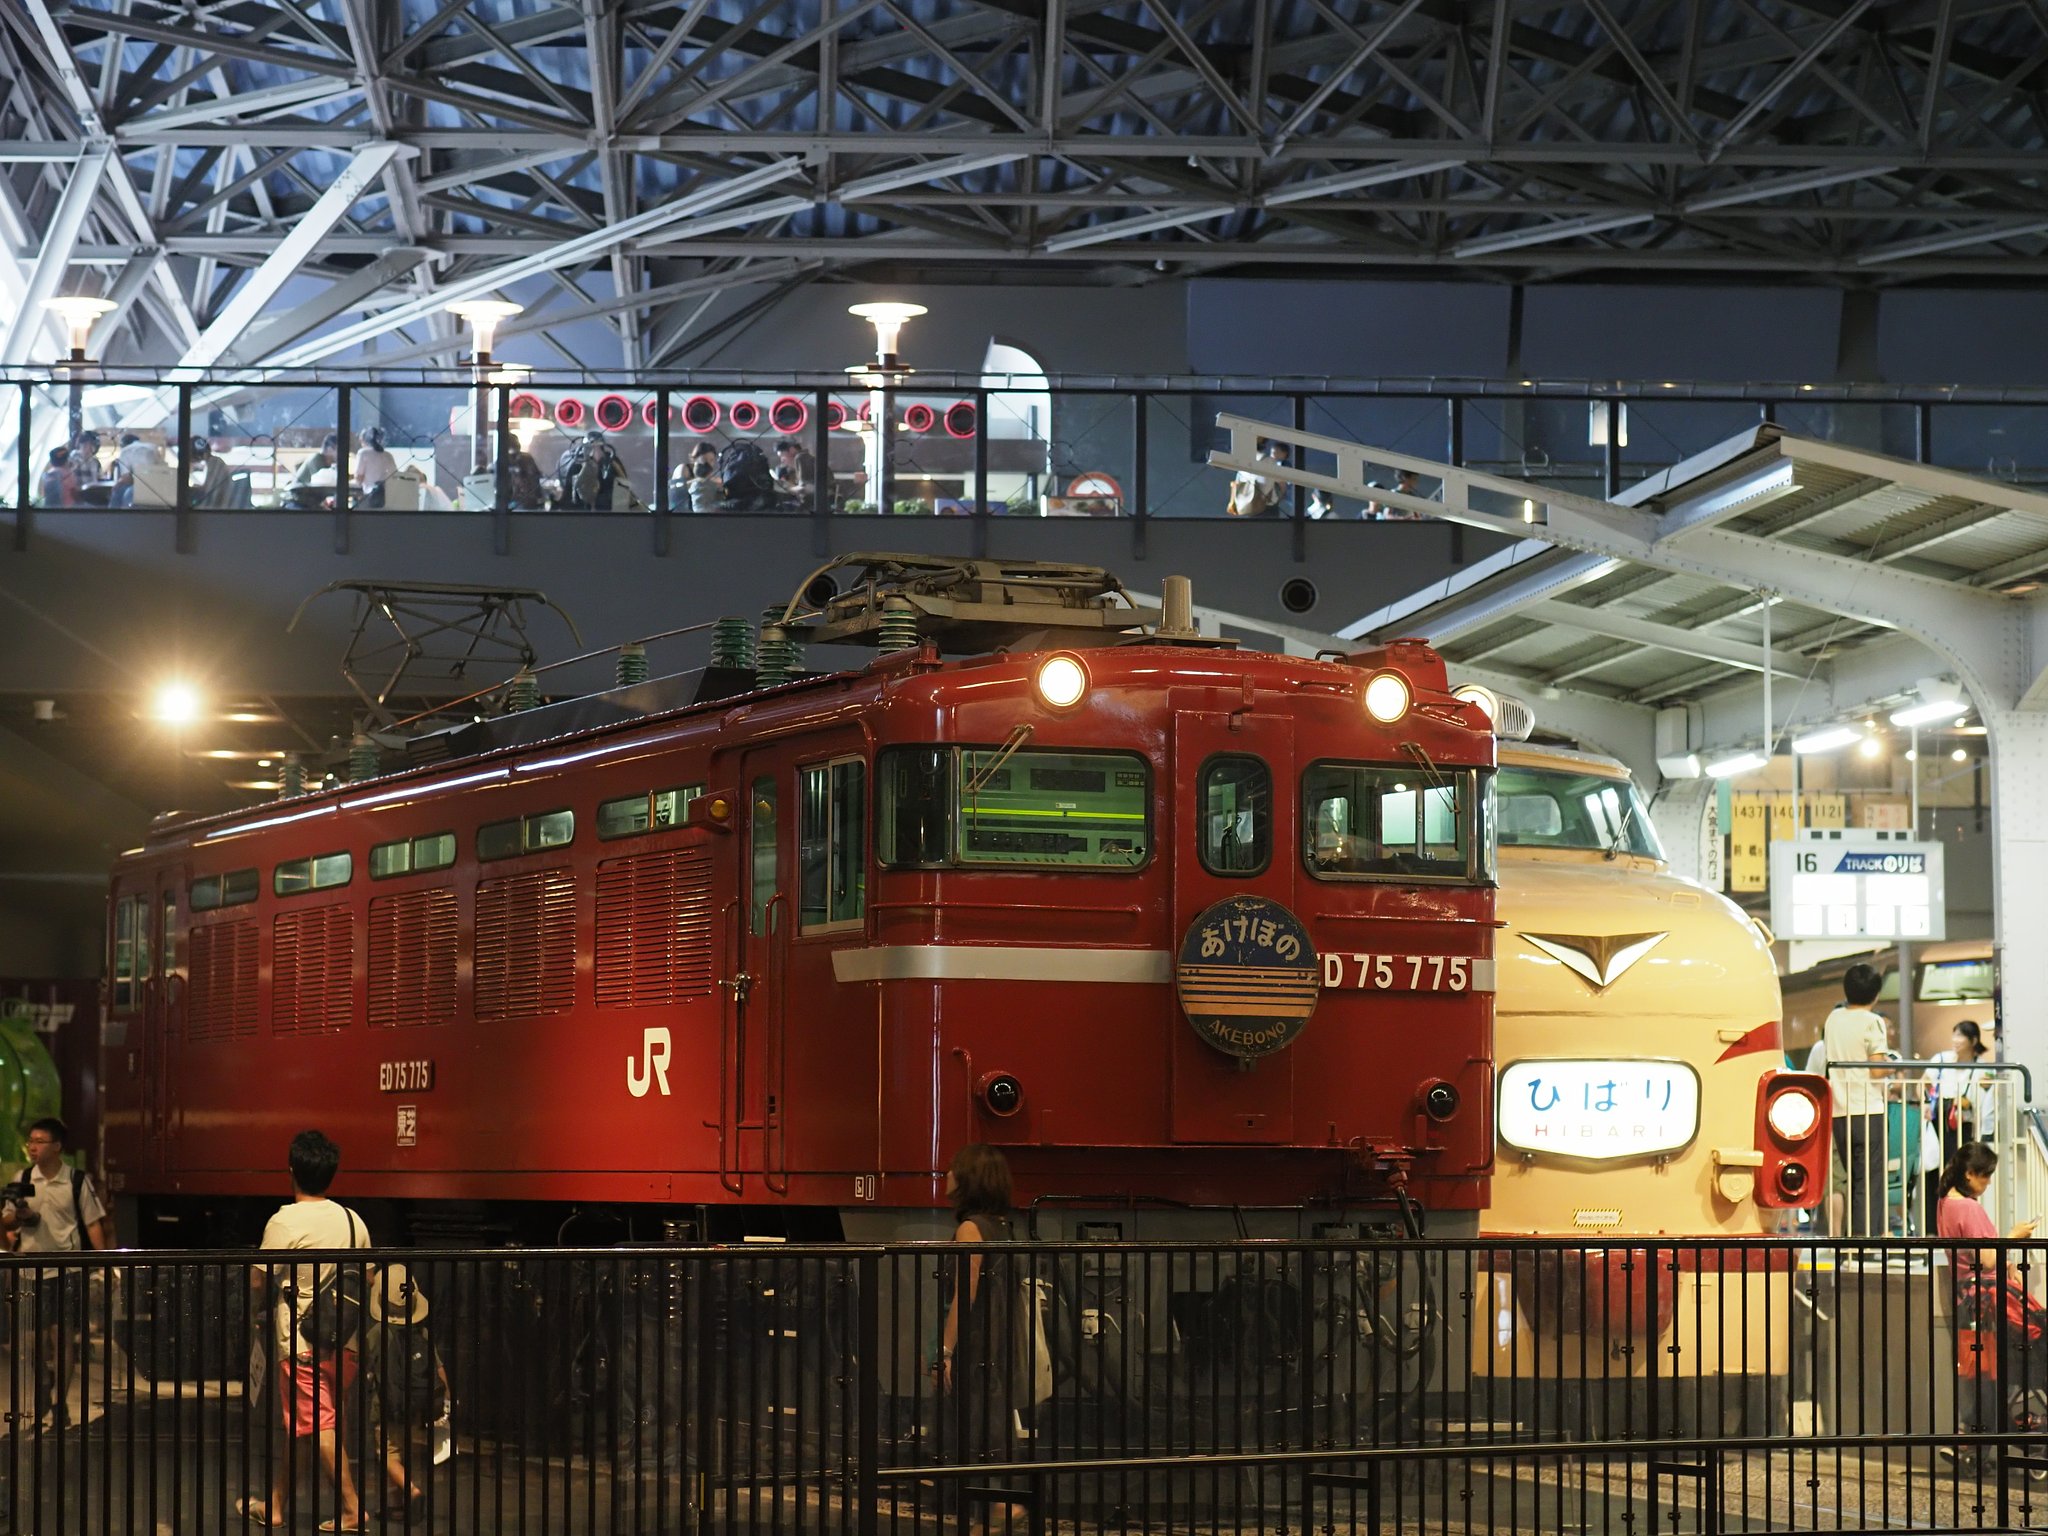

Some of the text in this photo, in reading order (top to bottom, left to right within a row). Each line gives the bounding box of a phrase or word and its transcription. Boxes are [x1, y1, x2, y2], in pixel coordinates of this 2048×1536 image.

[1734, 806, 1763, 817] 1437
[1815, 805, 1842, 818] 1121
[1796, 853, 1817, 872] 16
[1200, 915, 1302, 961] あけぼの
[1317, 954, 1467, 991] D 75 775
[1209, 1019, 1287, 1045] AKEBONO
[380, 1061, 428, 1090] ED 75 775
[627, 1027, 672, 1098] JR
[1528, 1078, 1672, 1112] ひばり
[1535, 1124, 1664, 1137] HIBARI
